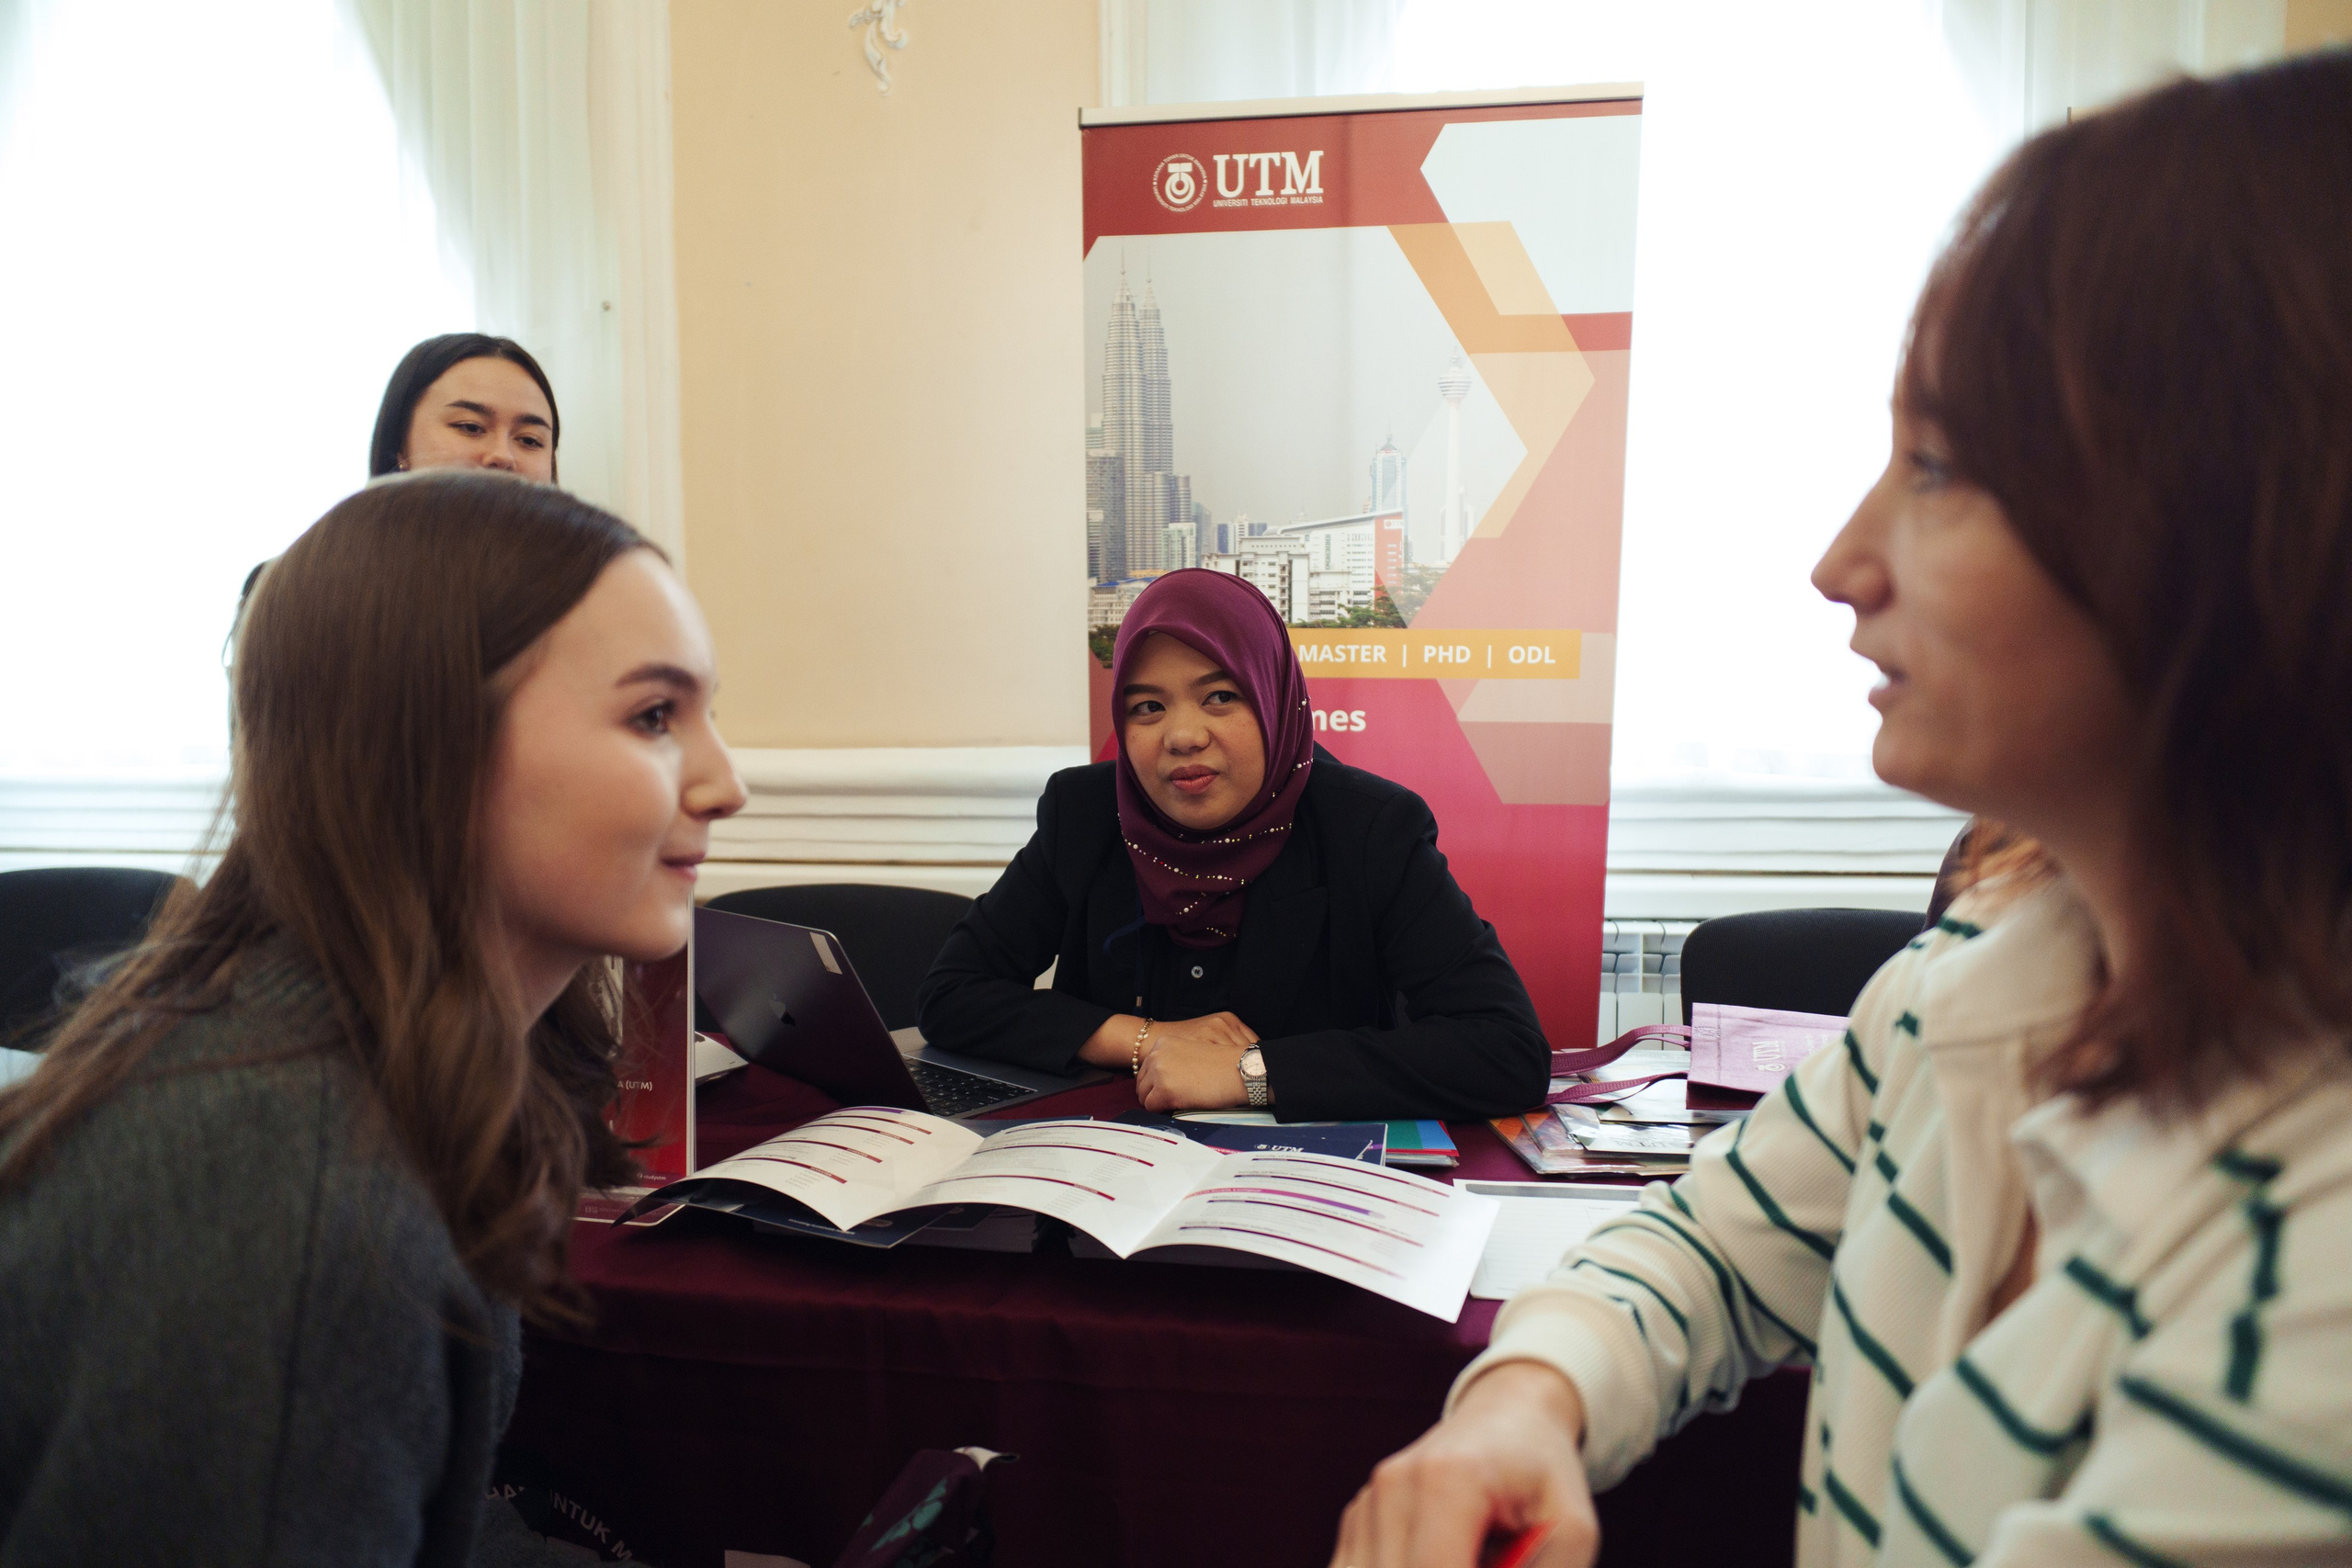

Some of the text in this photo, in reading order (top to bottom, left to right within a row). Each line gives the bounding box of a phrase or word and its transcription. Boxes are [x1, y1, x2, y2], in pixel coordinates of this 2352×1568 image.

[1213, 150, 1324, 198] UTM
[1213, 196, 1324, 208] UNIVERSITI TEKNOLOGI MALAYSIA
[1299, 644, 1387, 663] MASTER
[1423, 645, 1472, 663] PHD
[1509, 645, 1556, 664] ODL
[1752, 1040, 1781, 1062] UTM
[1270, 1145, 1305, 1153] UTM
[548, 1488, 613, 1544] NTUK
